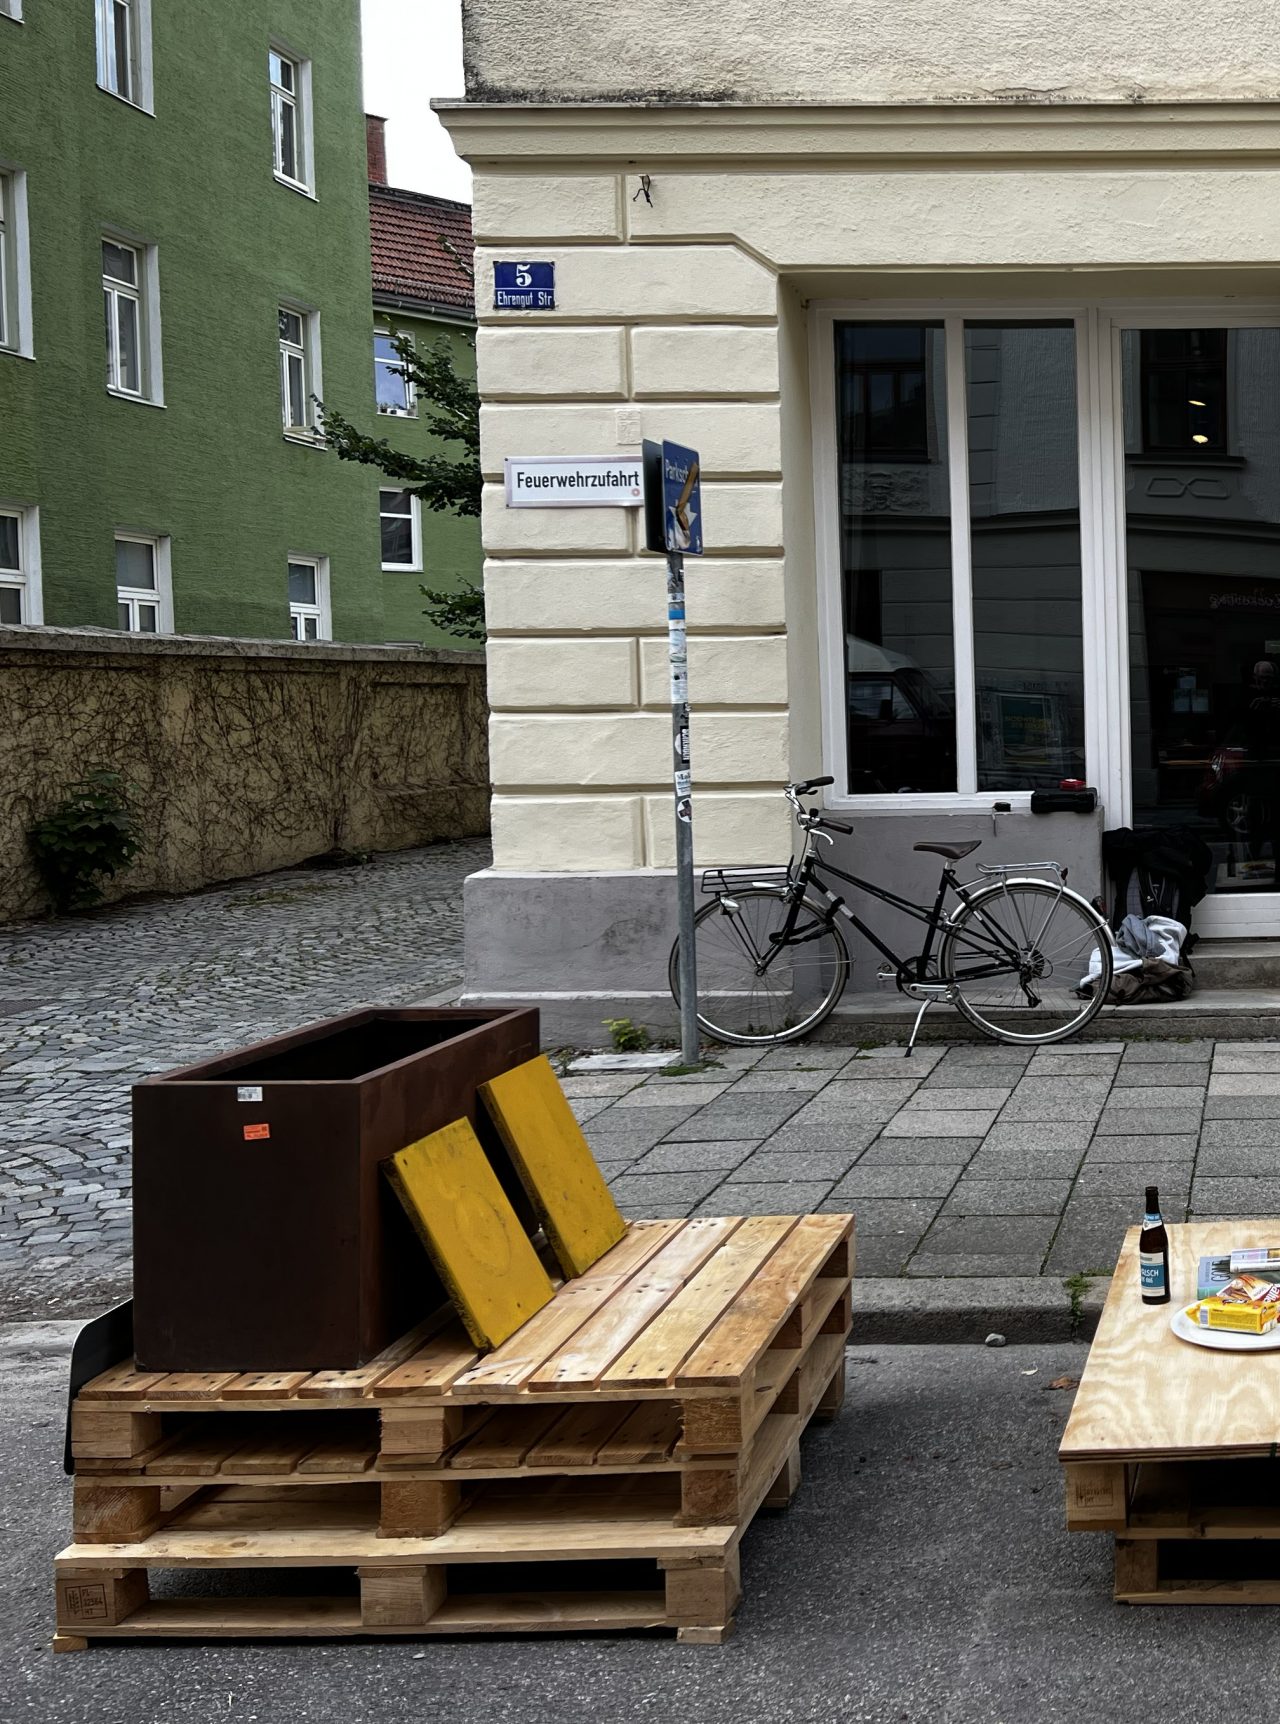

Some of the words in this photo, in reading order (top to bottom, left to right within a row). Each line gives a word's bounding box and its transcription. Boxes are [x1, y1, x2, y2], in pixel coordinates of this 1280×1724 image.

[516, 264, 532, 287] 5
[497, 291, 534, 307] Ehrengut
[516, 470, 640, 489] Feuerwehrzufahrt
